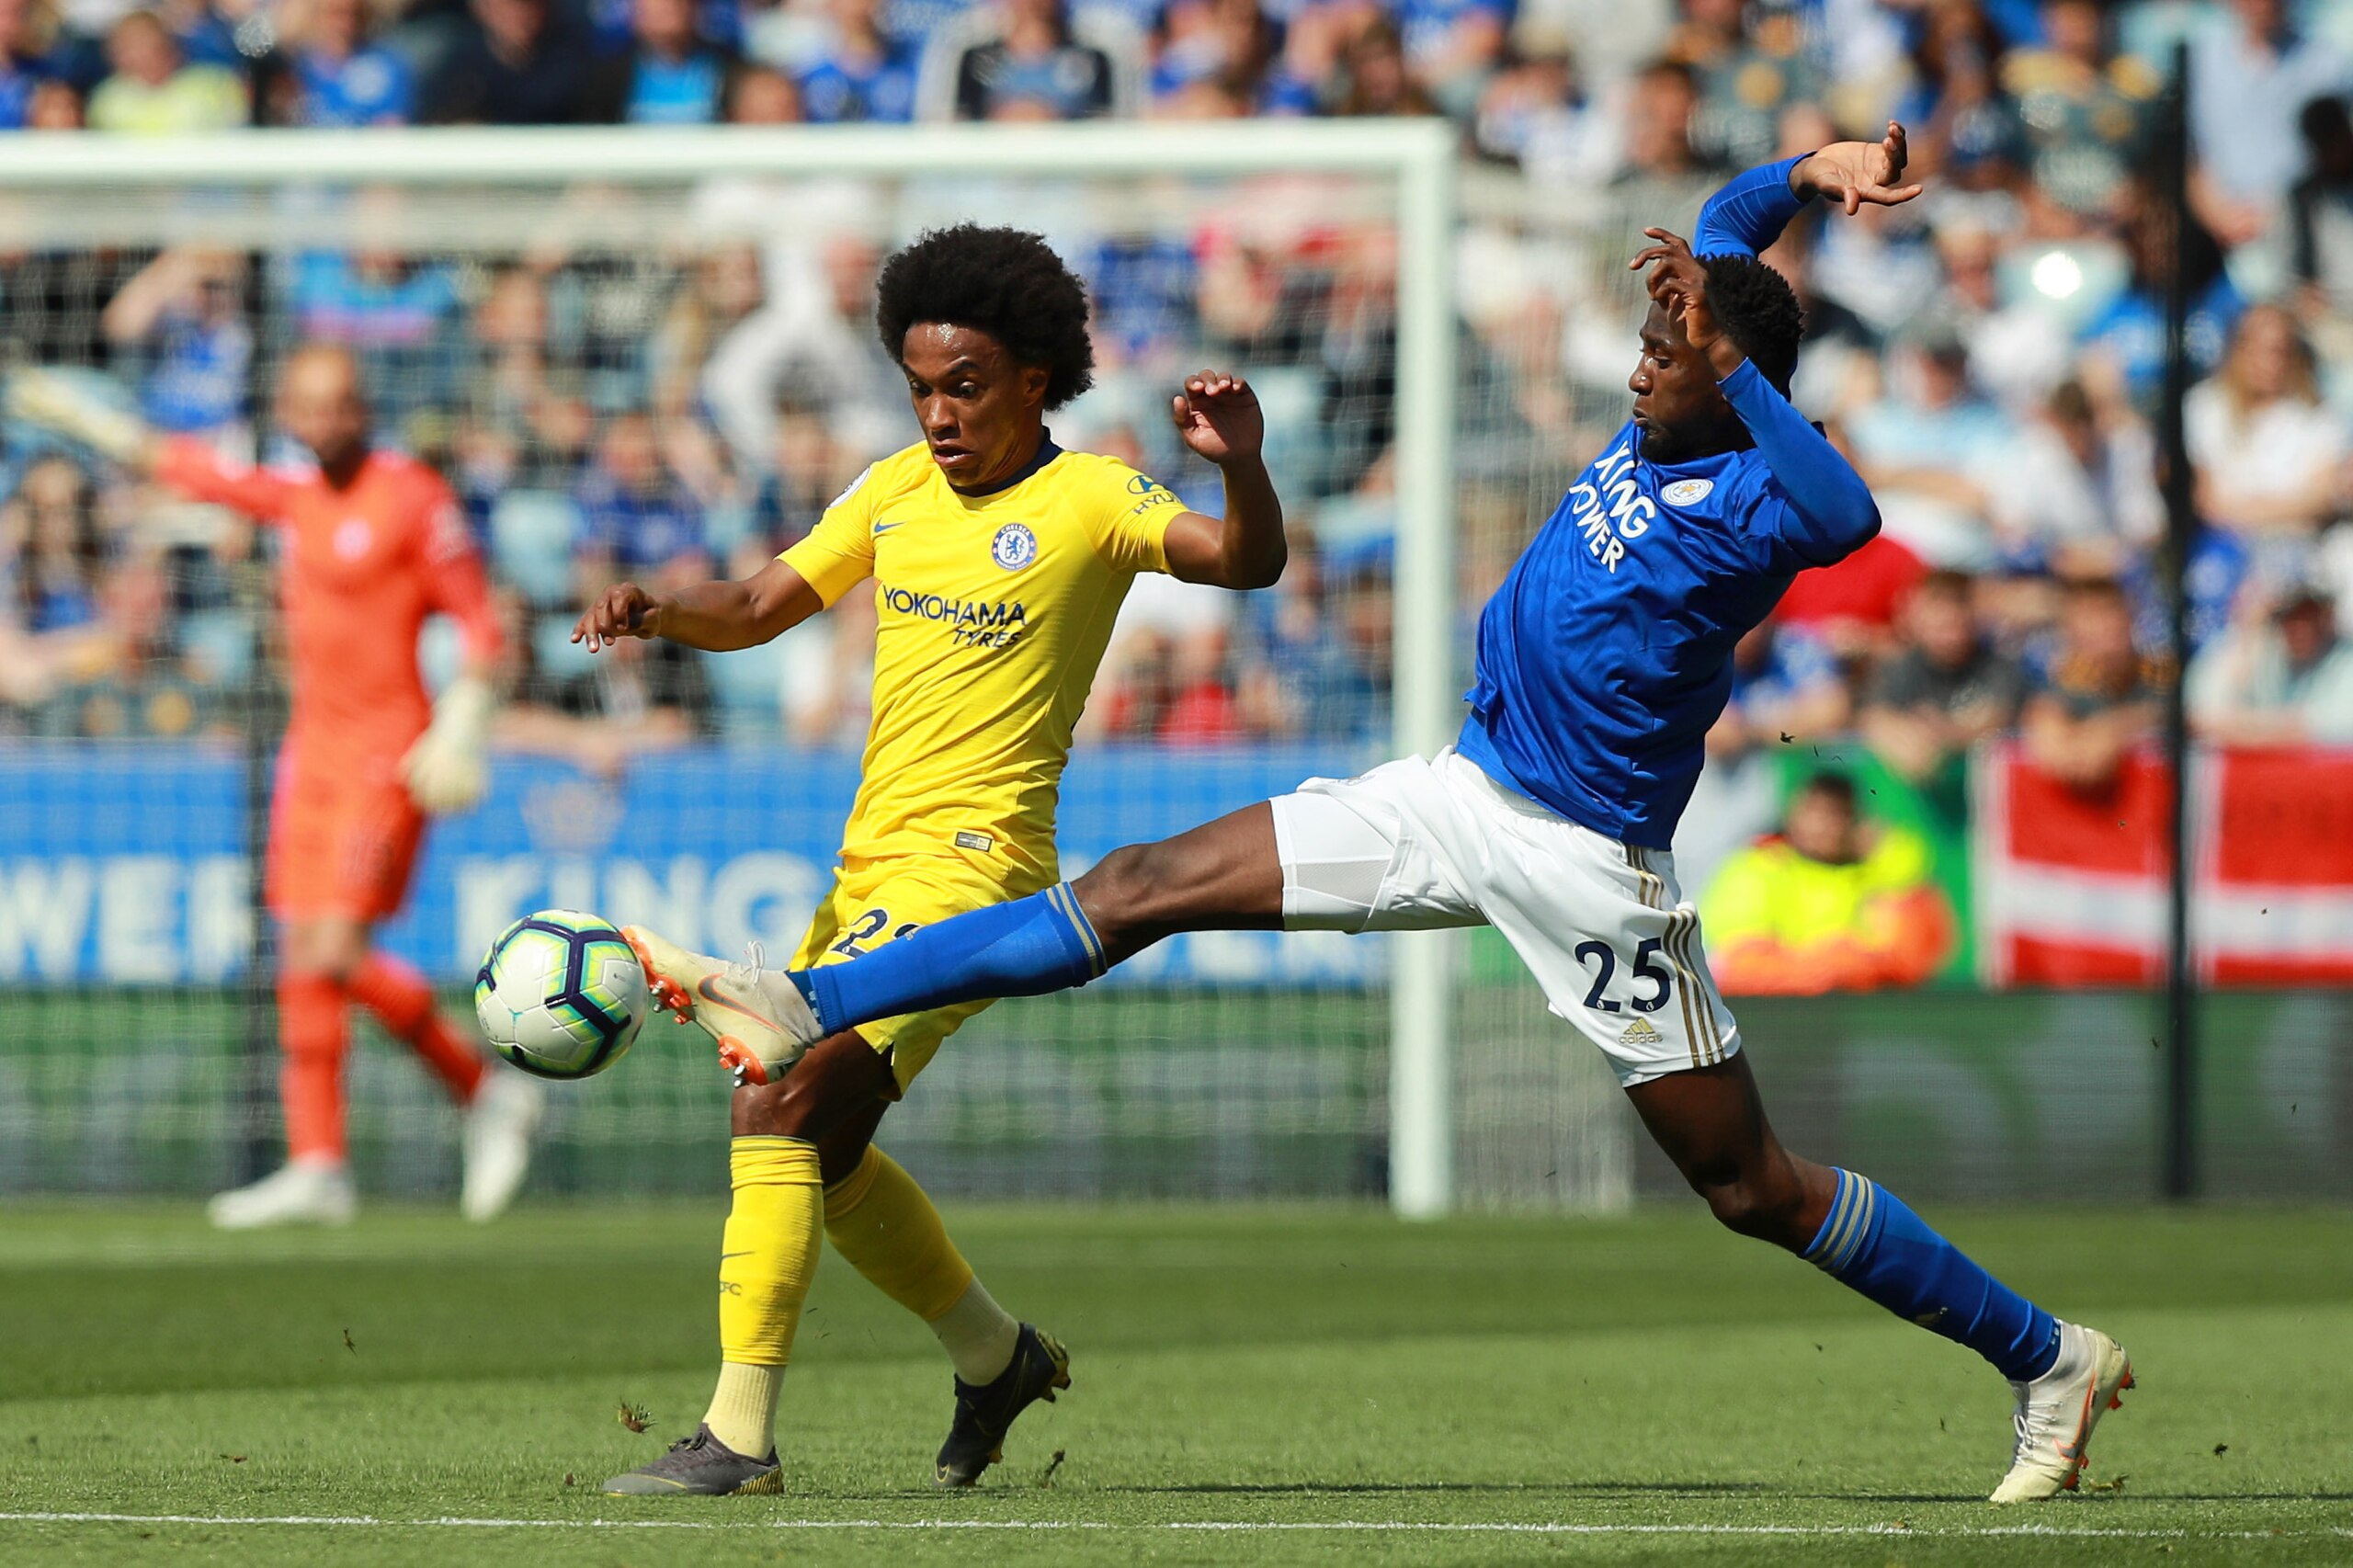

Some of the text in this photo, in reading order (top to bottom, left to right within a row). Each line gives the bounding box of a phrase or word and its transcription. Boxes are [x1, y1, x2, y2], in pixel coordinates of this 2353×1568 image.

[1001, 524, 1030, 537] CHELSEA
[882, 585, 1028, 627] YOKOHAMA
[952, 628, 1023, 648] TYRES
[456, 849, 825, 972] KING
[830, 907, 920, 960] 2
[1574, 937, 1671, 1013] 25
[1618, 1033, 1664, 1045] adidas
